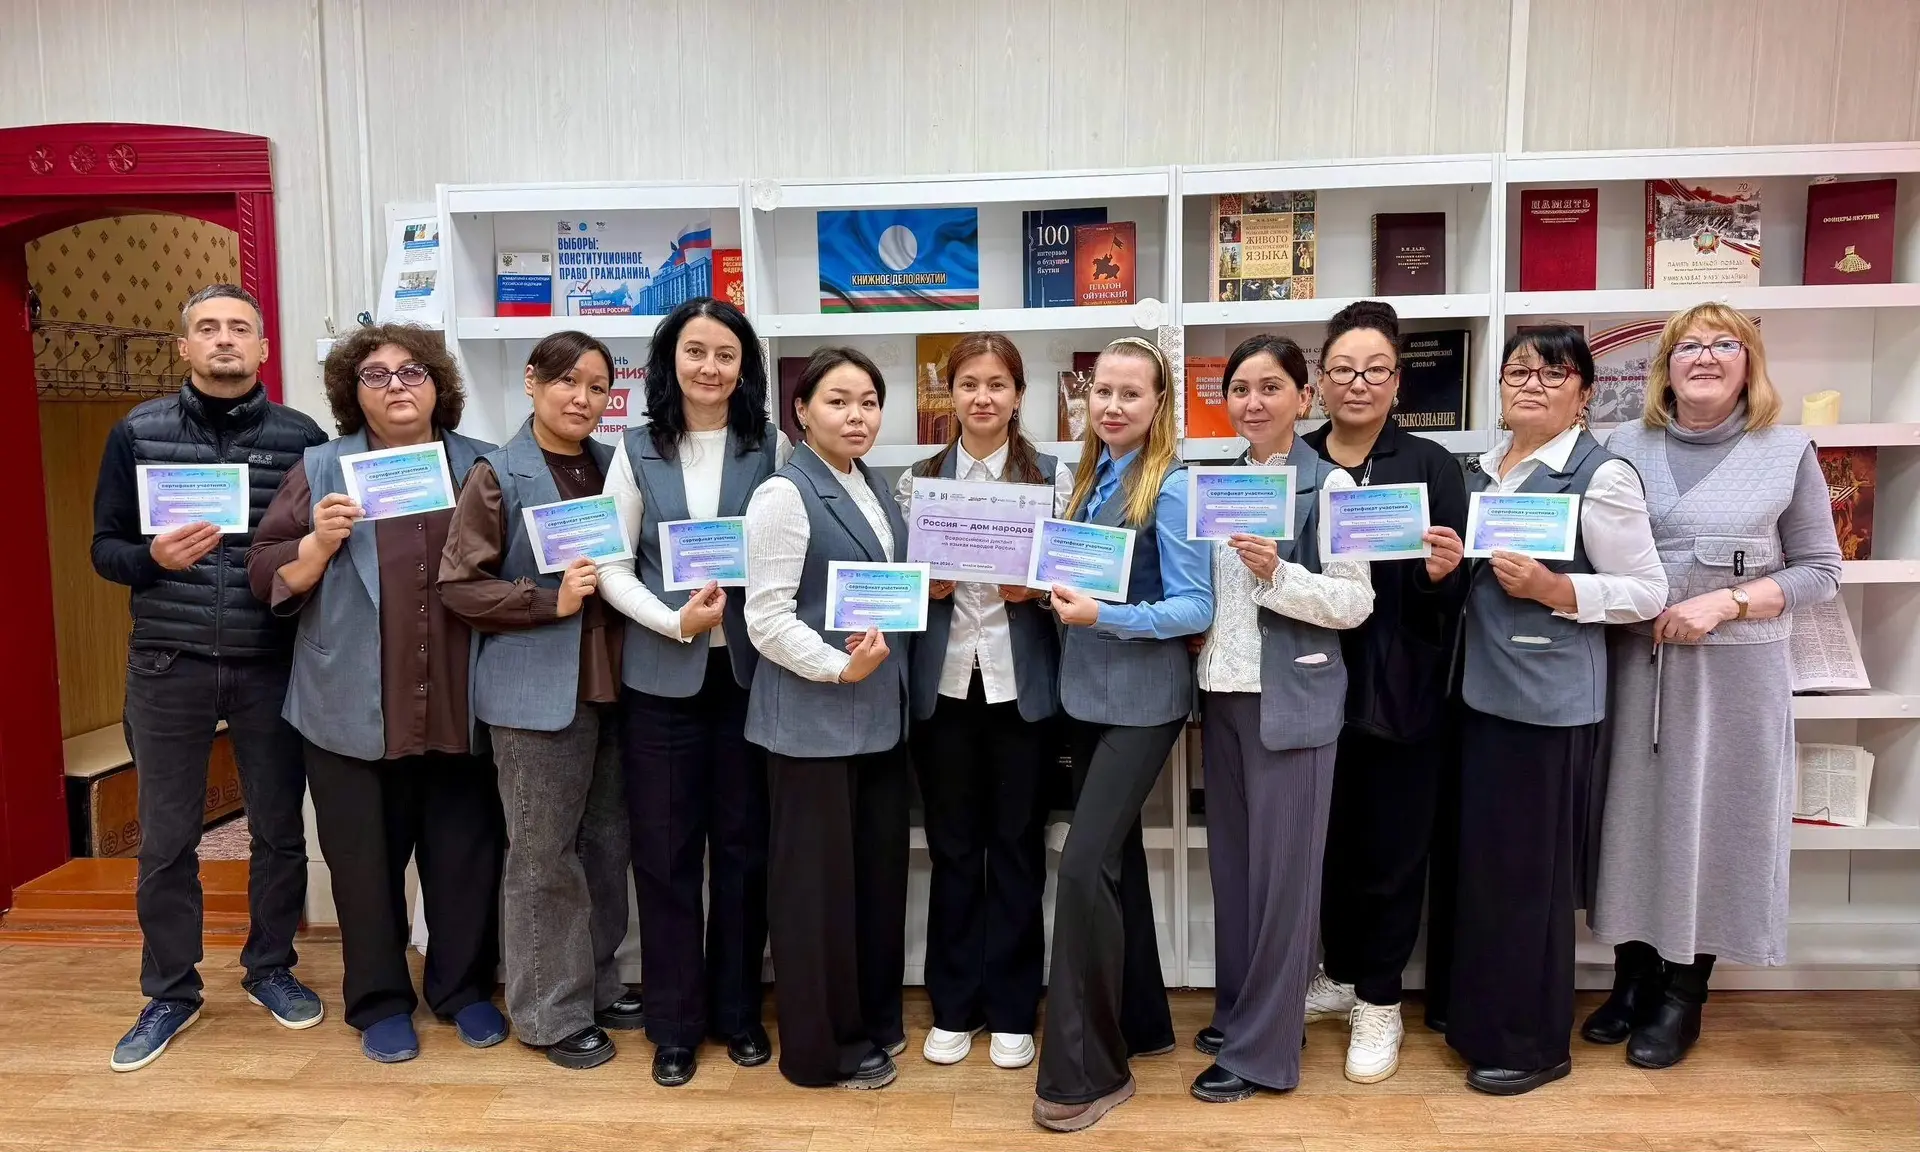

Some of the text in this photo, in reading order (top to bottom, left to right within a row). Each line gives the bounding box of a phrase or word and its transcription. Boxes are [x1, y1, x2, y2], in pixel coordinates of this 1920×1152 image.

[1531, 199, 1591, 209] ПАМЯТЬ
[1036, 224, 1070, 246] 100
[1246, 235, 1288, 244] ЖИВОГО
[557, 237, 599, 250] ВЫБОРЫ:
[559, 251, 643, 266] КОНСТИТУЦИОННОЕ
[1246, 250, 1288, 260] ЯЗЫКА
[1042, 258, 1070, 267] будущем
[559, 266, 650, 280] ПРАВО ГРАЖДАНИНА
[1037, 267, 1060, 275] Якутии
[852, 273, 946, 285] КНИЖНОЕ ДЕЛО ЯКУТИИ
[1089, 283, 1121, 291] ПЛАТОН
[1082, 290, 1128, 300] ОЙУНСКИЙ
[922, 518, 958, 529] Россия
[970, 523, 990, 531] дом
[991, 524, 1034, 534] народов
[945, 535, 989, 543] Всероссийский
